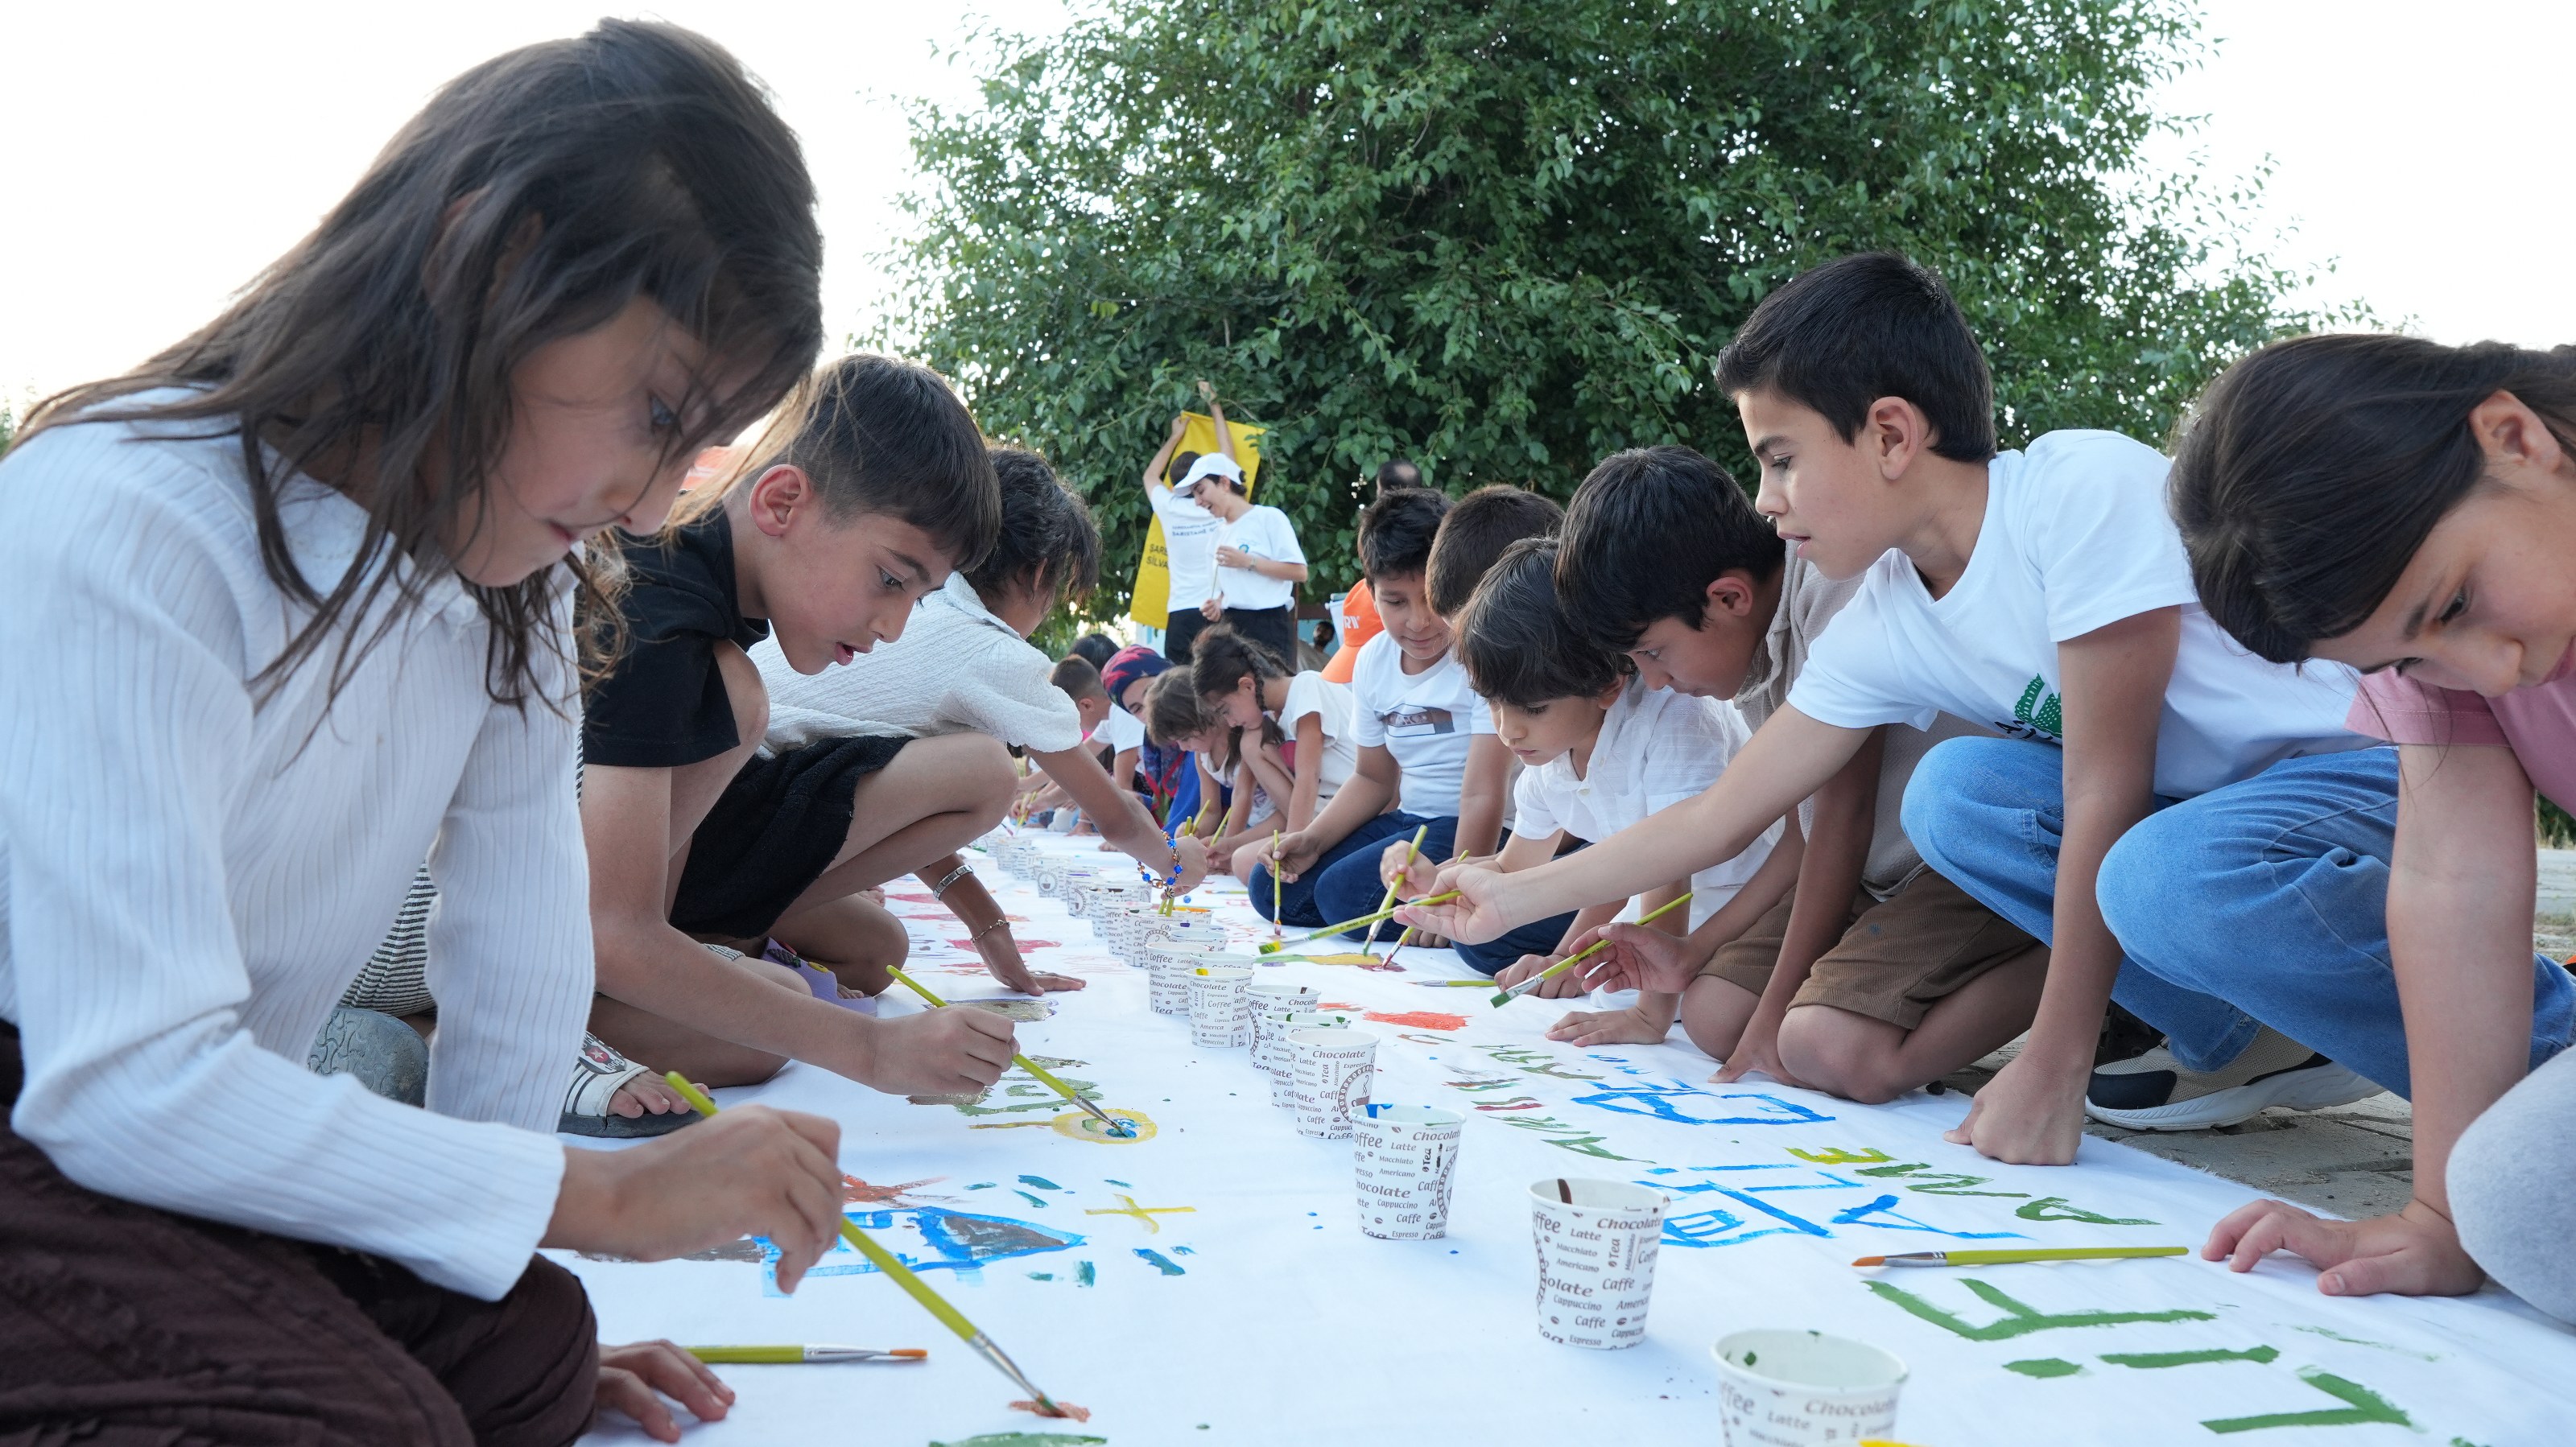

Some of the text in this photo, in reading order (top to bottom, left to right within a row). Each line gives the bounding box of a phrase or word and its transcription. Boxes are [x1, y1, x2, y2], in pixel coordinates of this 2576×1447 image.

[1150, 953, 1173, 963] Coffee
[1150, 979, 1187, 990] Chocolate
[1190, 981, 1227, 991] Chocolate
[1155, 1006, 1173, 1015] Tea
[1248, 999, 1269, 1011] offee
[1312, 1050, 1366, 1059] Chocolate
[1299, 1057, 1316, 1066] Latte
[1320, 1090, 1340, 1100] Caff
[1307, 1115, 1325, 1124] Caffe
[1353, 1132, 1383, 1148] offee
[1413, 1129, 1460, 1141] Chocolat
[1391, 1142, 1417, 1152] Latte
[1354, 1151, 1365, 1162] ffe
[1379, 1156, 1414, 1165] Macchiato
[1422, 1148, 1431, 1165] Tea
[1355, 1166, 1373, 1178] resso
[1379, 1168, 1415, 1178] Americano
[1356, 1178, 1411, 1198] hocolate
[1418, 1180, 1439, 1192] Caff
[1377, 1198, 1418, 1210] Cappuccino
[1396, 1214, 1422, 1224] Caffe
[1533, 1210, 1561, 1234] ffee
[1597, 1217, 1662, 1230] Chocolat
[1392, 1231, 1418, 1239] Espresso
[1571, 1228, 1602, 1241] Latte
[1556, 1243, 1598, 1257] Macchiato
[1608, 1239, 1620, 1258] Tea
[1557, 1258, 1600, 1272] Americano
[1602, 1277, 1635, 1292] Caffe
[1554, 1294, 1602, 1311] Cappuccino
[1575, 1315, 1606, 1329] Caffe
[1569, 1334, 1602, 1346] Espresso
